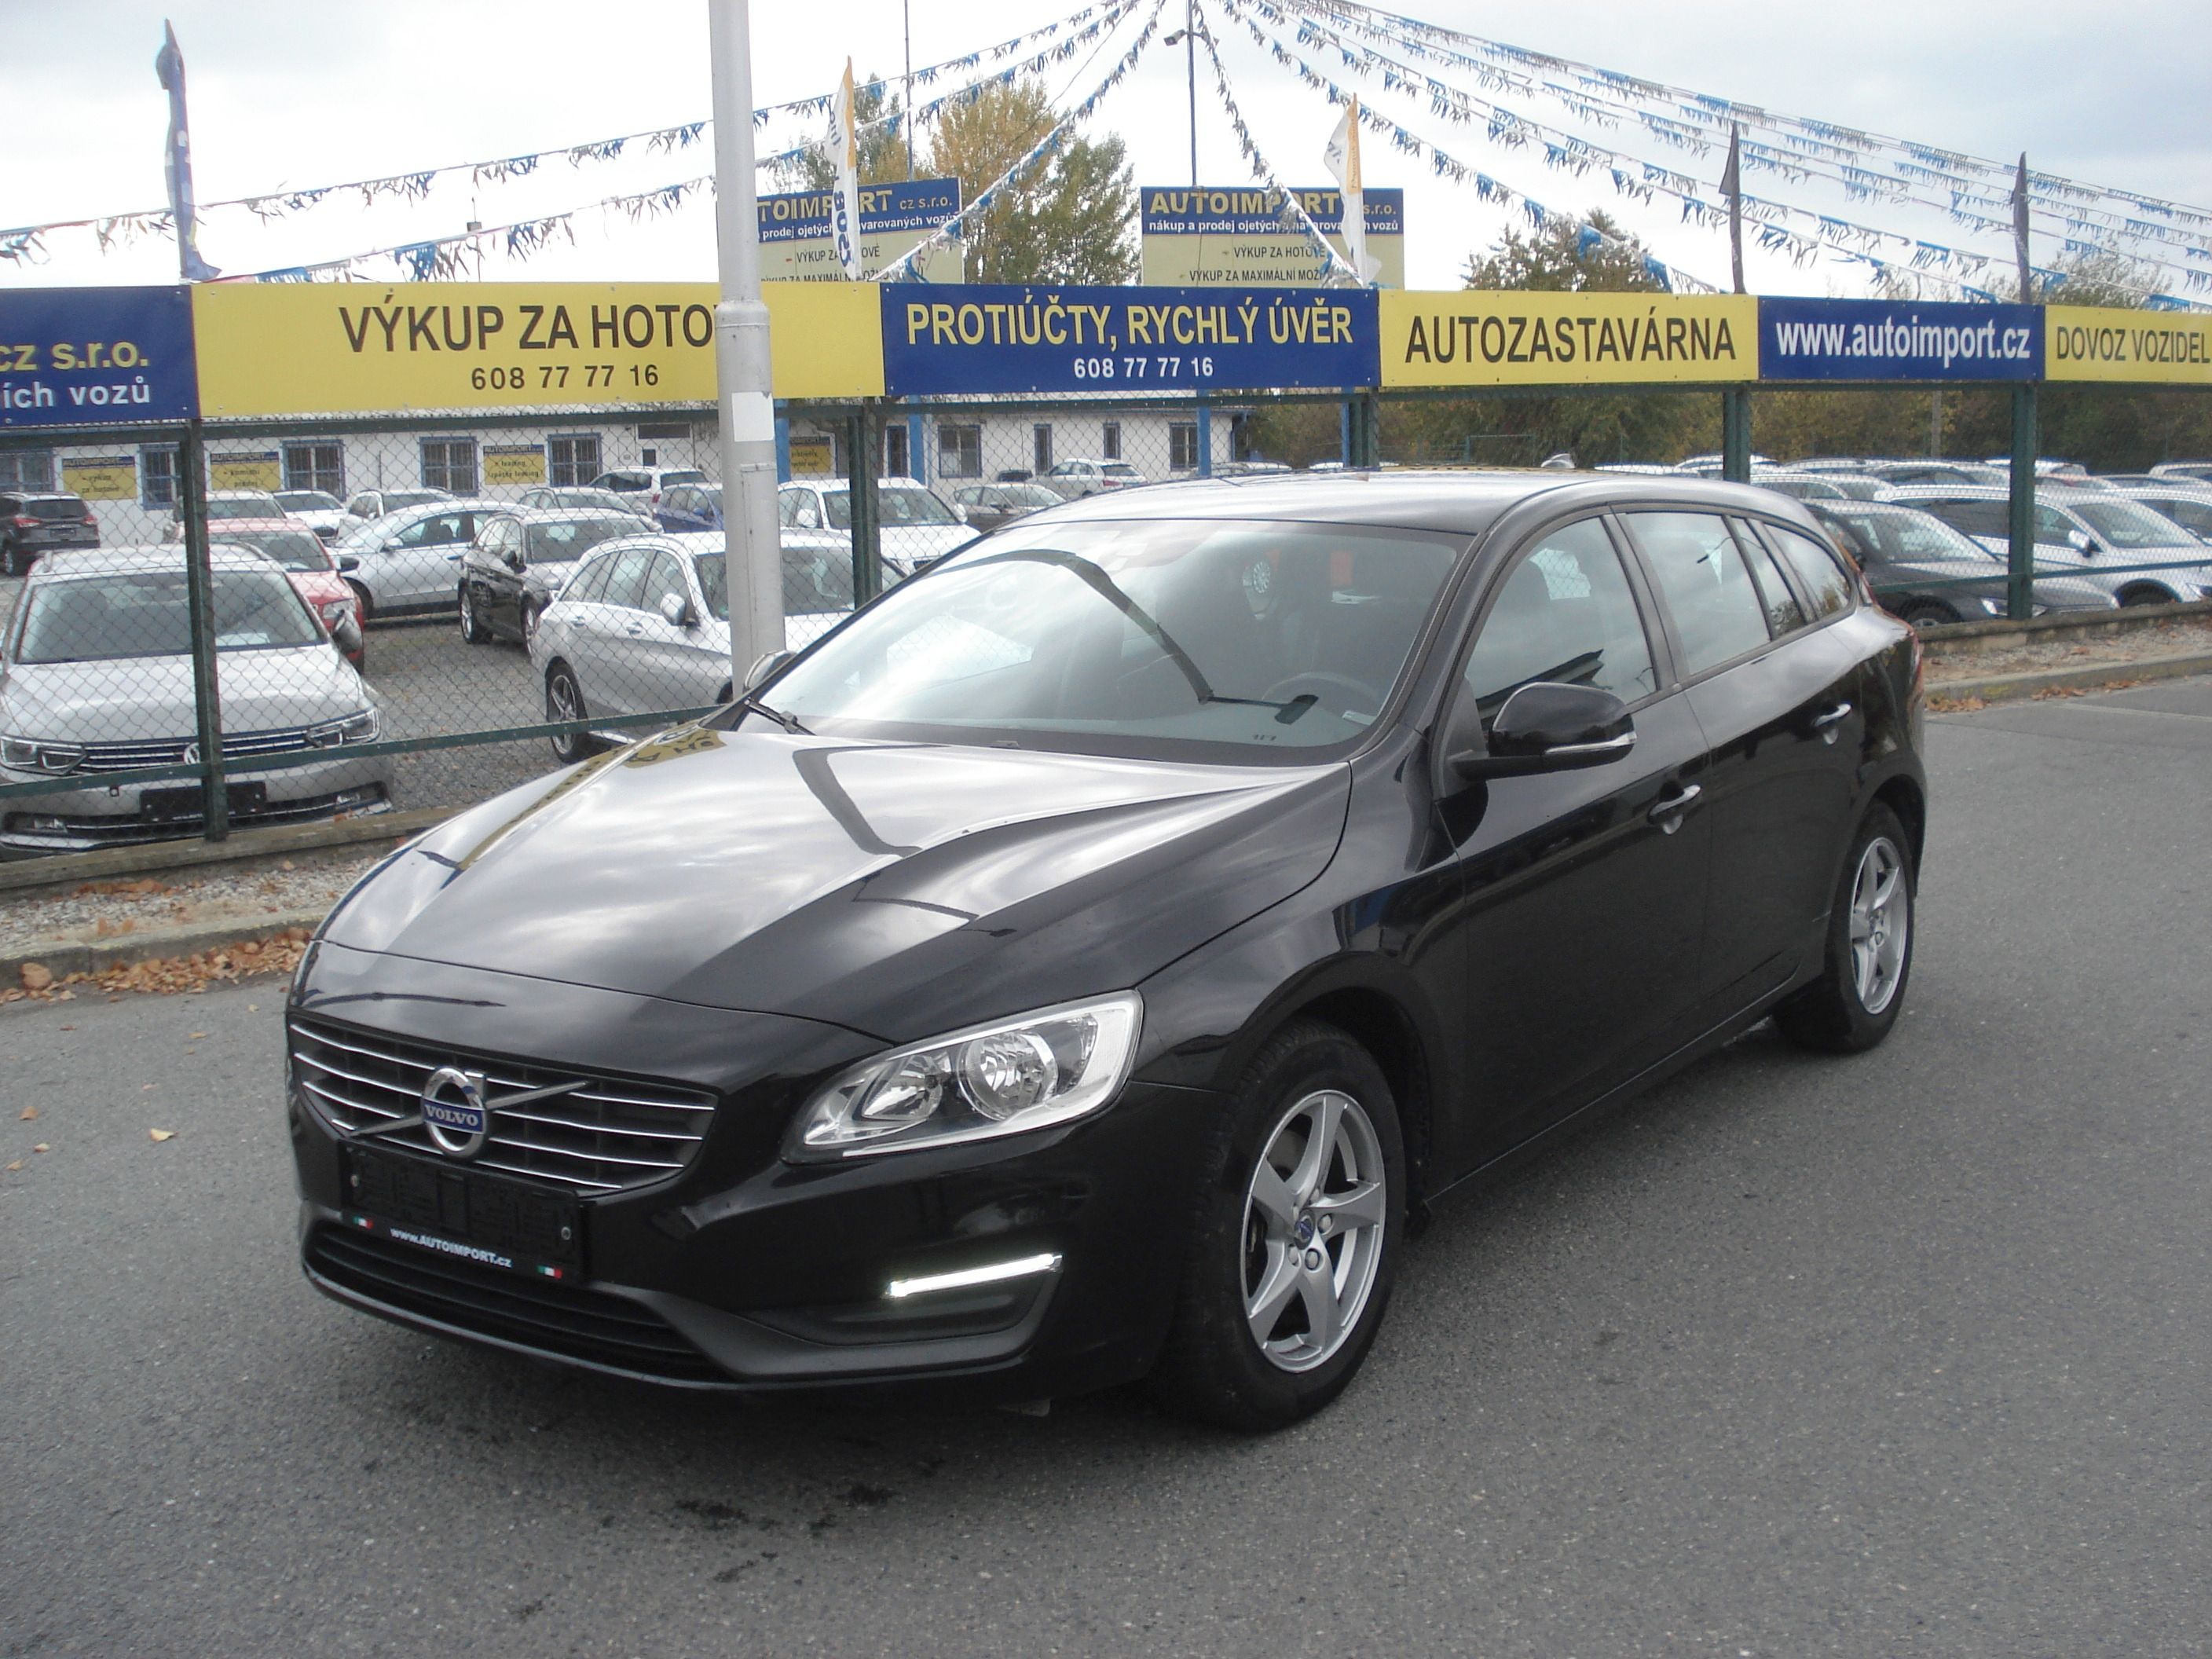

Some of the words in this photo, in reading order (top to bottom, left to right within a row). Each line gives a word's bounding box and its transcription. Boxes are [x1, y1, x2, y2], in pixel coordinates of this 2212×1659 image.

[757, 190, 892, 222] TOIMPRT
[899, 200, 914, 210] cz
[918, 196, 953, 208] s.r.o.
[763, 225, 795, 240] prodej
[1149, 220, 1185, 233] nákup
[1188, 222, 1195, 230] a
[1199, 220, 1235, 233] prodej
[1372, 219, 1398, 230] vozů
[797, 247, 826, 263] VÝKUP
[1234, 245, 1267, 258] VÝKUP
[1270, 247, 1283, 258] ZA
[1189, 269, 1222, 281] VÝKUP
[1226, 270, 1238, 281] ZA
[1242, 267, 1295, 281] MAXIMÁLNÍ
[1298, 267, 1321, 281] MOŽ
[339, 294, 504, 353] VÝKUP
[519, 305, 579, 349] ZA
[591, 304, 718, 348] HOTO
[906, 295, 1118, 352] PROTIÚČTY,
[1126, 297, 1259, 344] RYCHLÝ
[1269, 297, 1353, 344] ÚVĚR
[1405, 306, 1737, 363] AUTOZASTAVÁRNA
[52, 341, 149, 370] s.r.o.
[1776, 315, 2031, 368] www.autoimport.cz
[2056, 326, 2126, 362] DOVOZ
[2131, 328, 2211, 364] VOZIDEL
[471, 367, 526, 390] 608
[539, 365, 569, 388] 77
[584, 364, 614, 387] 77
[629, 364, 659, 386] 16
[1074, 357, 1115, 379] 608
[1123, 357, 1147, 378] 77
[1157, 357, 1181, 378] 77
[1191, 357, 1214, 376] 16
[69, 375, 150, 406] vozů
[425, 1104, 478, 1126] VOLVO
[390, 1228, 512, 1269] www.AUTOIMPORT.cz
